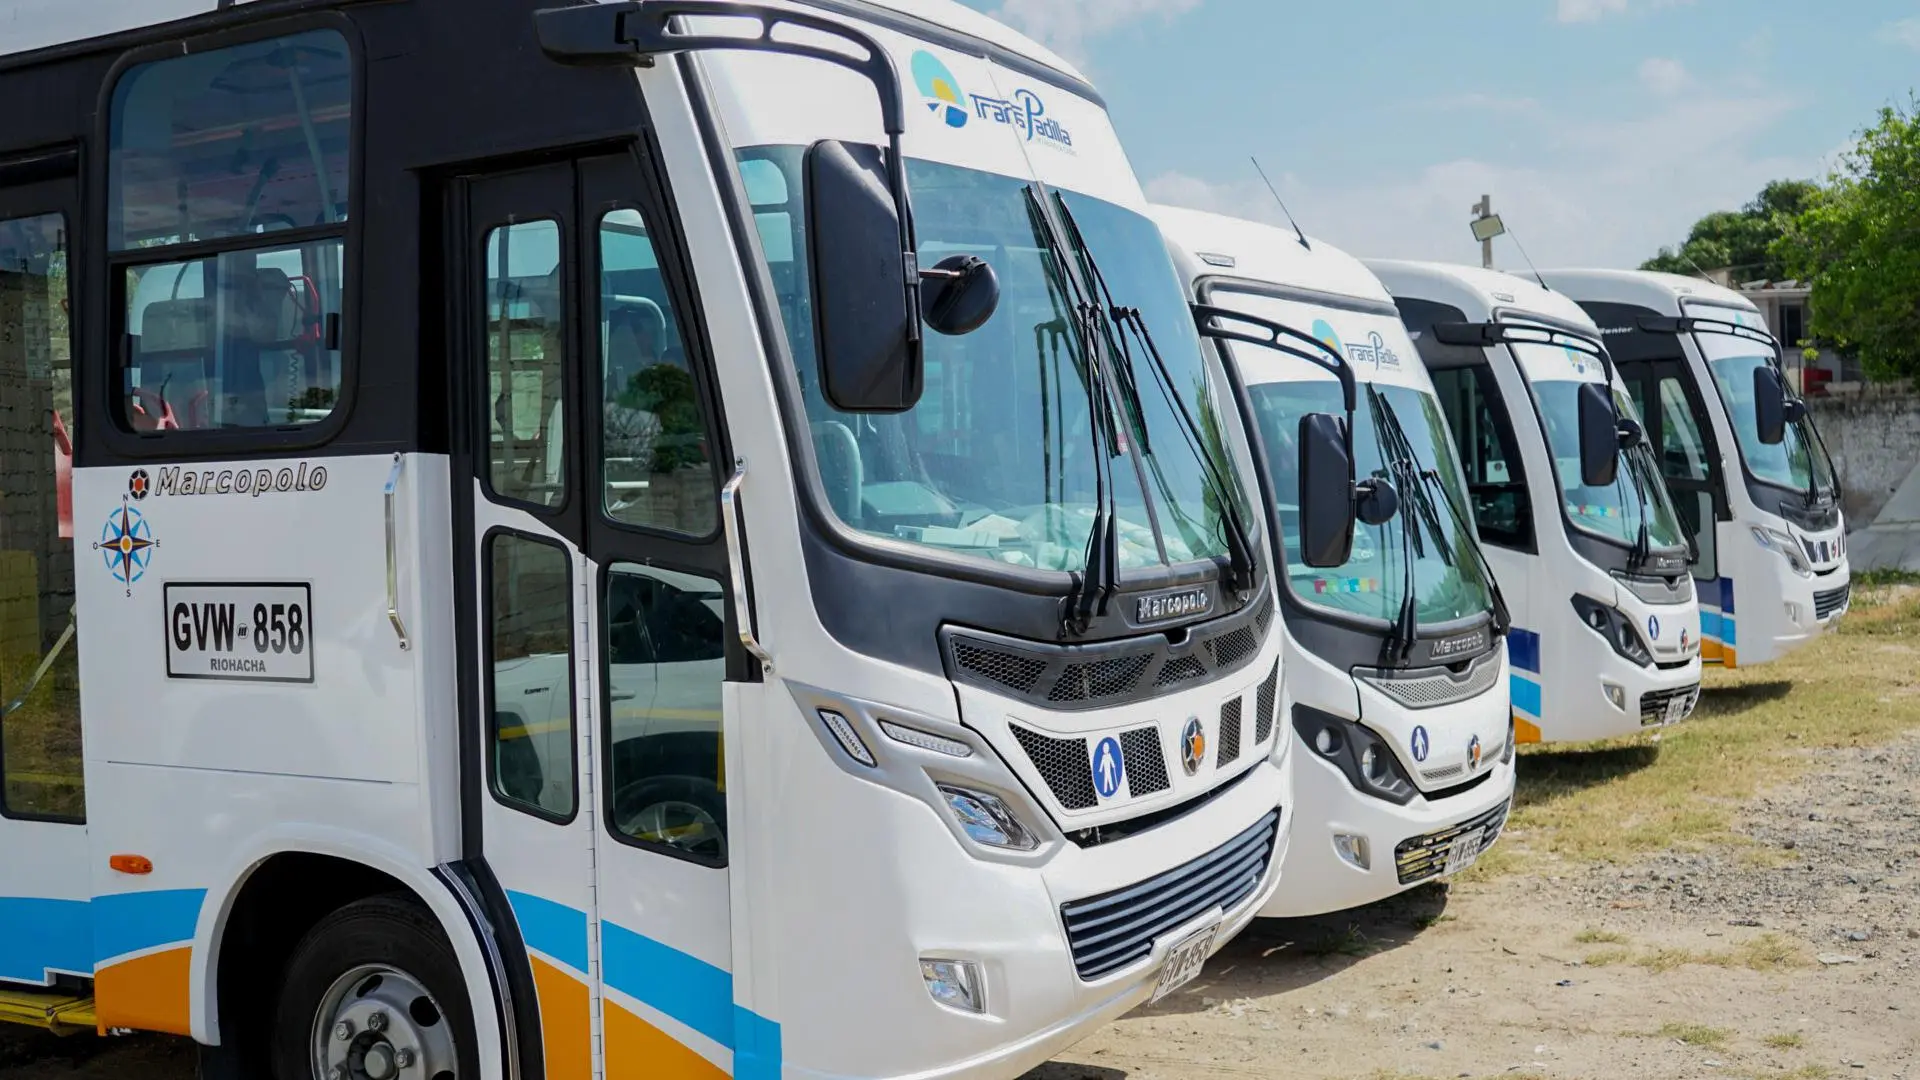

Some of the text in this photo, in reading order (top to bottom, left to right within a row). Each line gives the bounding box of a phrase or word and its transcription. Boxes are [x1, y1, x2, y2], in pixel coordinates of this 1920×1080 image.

[155, 461, 328, 497] Marcopolo
[155, 539, 160, 548] E
[126, 589, 131, 597] S
[1138, 590, 1208, 619] Marcopolo
[172, 602, 304, 655] GVW 858
[210, 658, 266, 672] RIOHACHA
